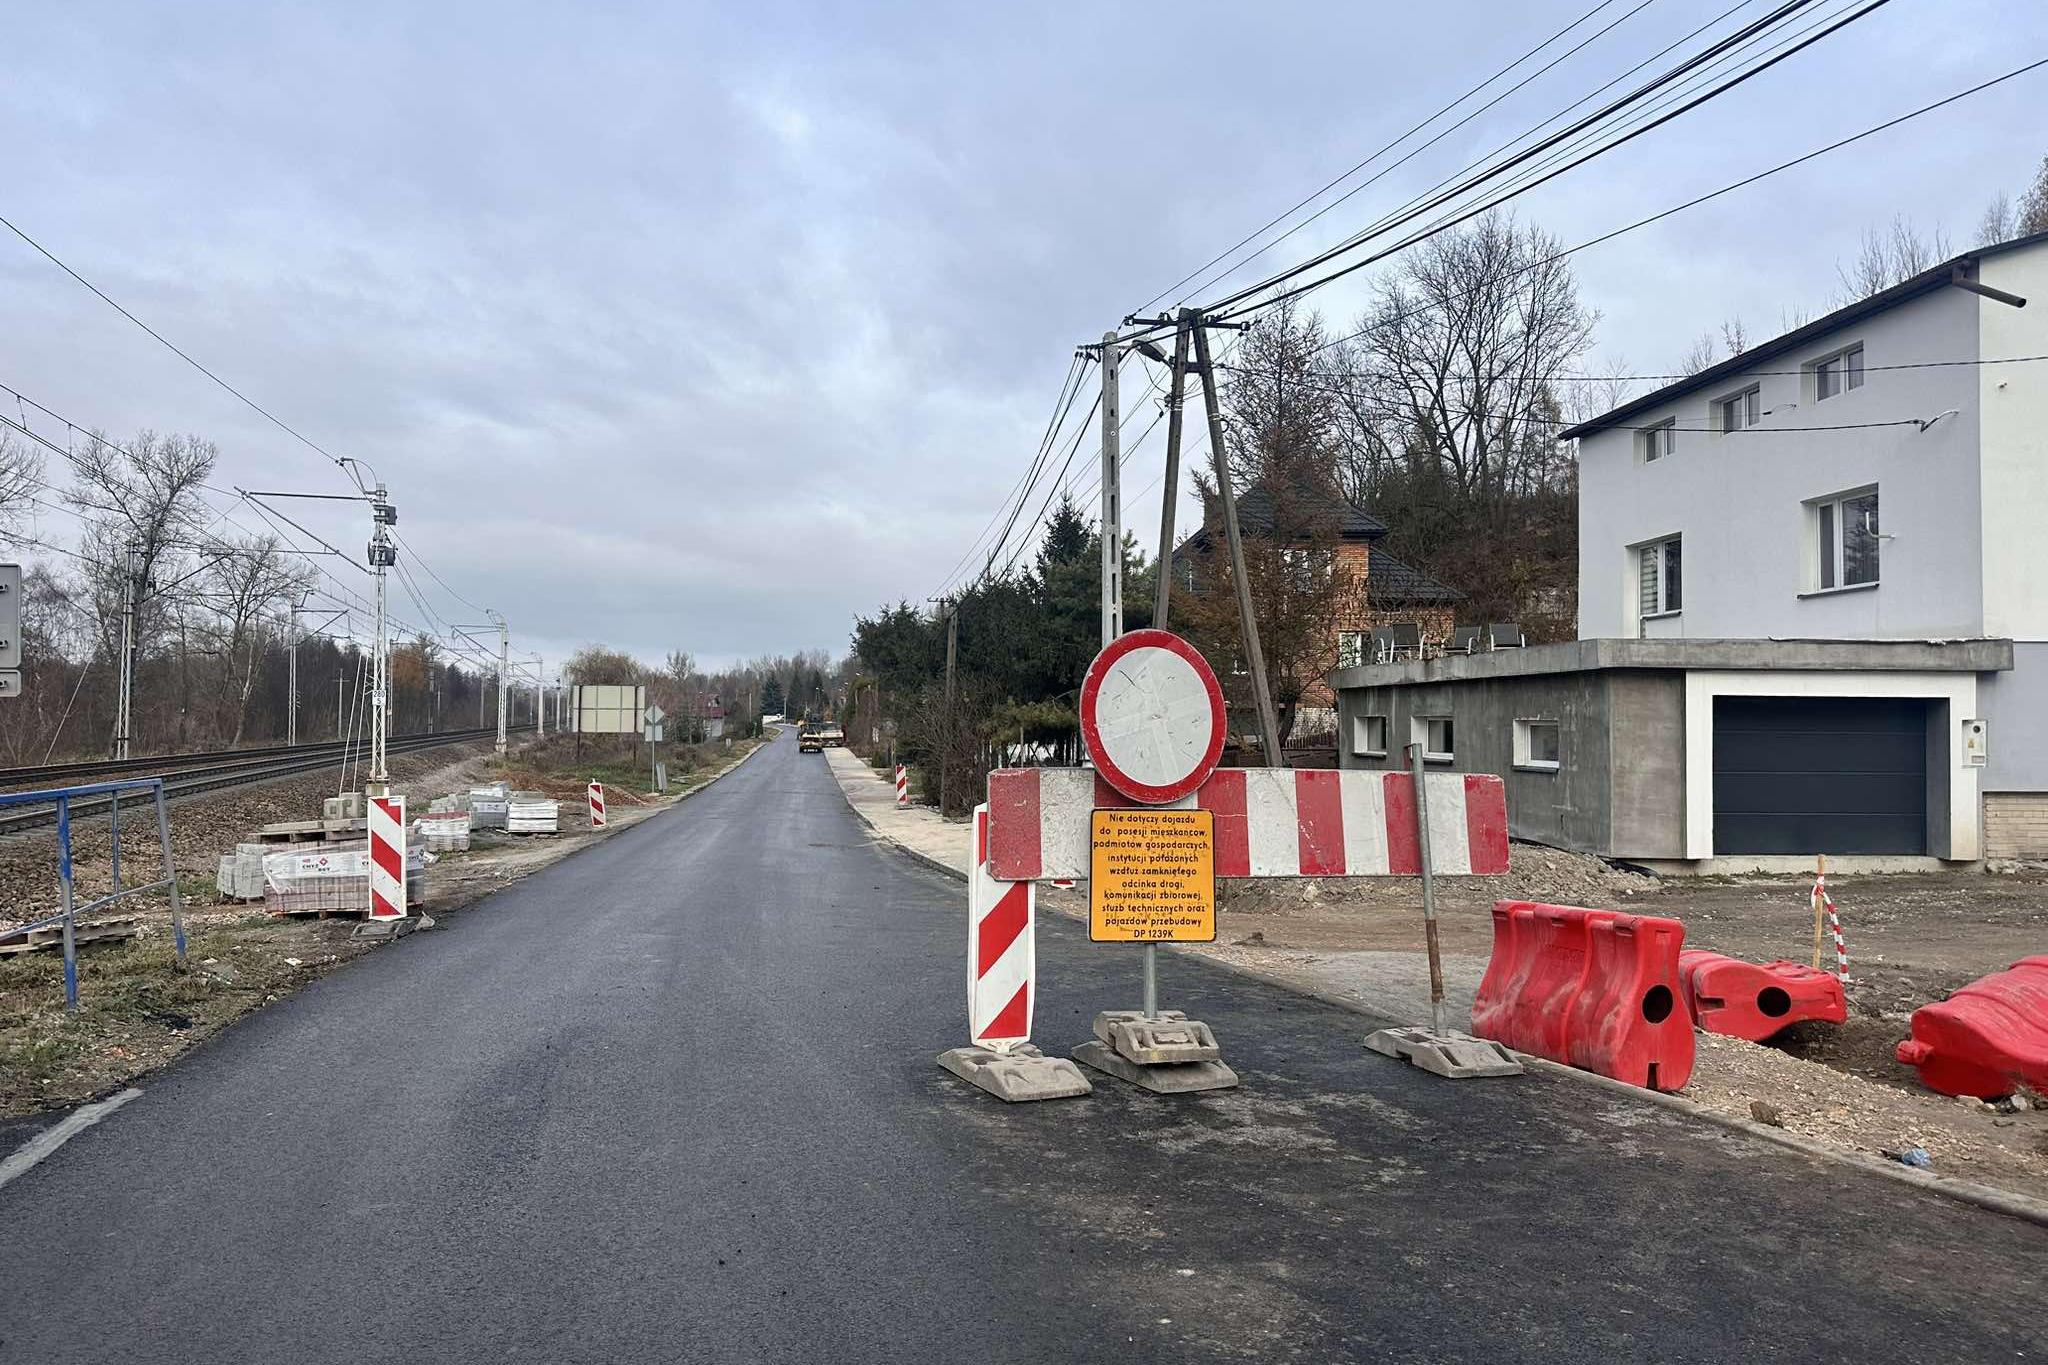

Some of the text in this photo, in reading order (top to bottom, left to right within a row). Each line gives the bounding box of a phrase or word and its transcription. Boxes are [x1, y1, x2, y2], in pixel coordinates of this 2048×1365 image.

[1110, 814, 1195, 824] Nie dotyczy dojazdu
[1118, 828, 1146, 837] posesji
[1108, 854, 1146, 863] instytucji
[1160, 880, 1184, 889] drogi,
[1104, 891, 1156, 901] komunikacji
[1128, 904, 1183, 913] technicznych
[1151, 917, 1202, 926] przebudowy
[1134, 930, 1173, 938] DP 1239K
